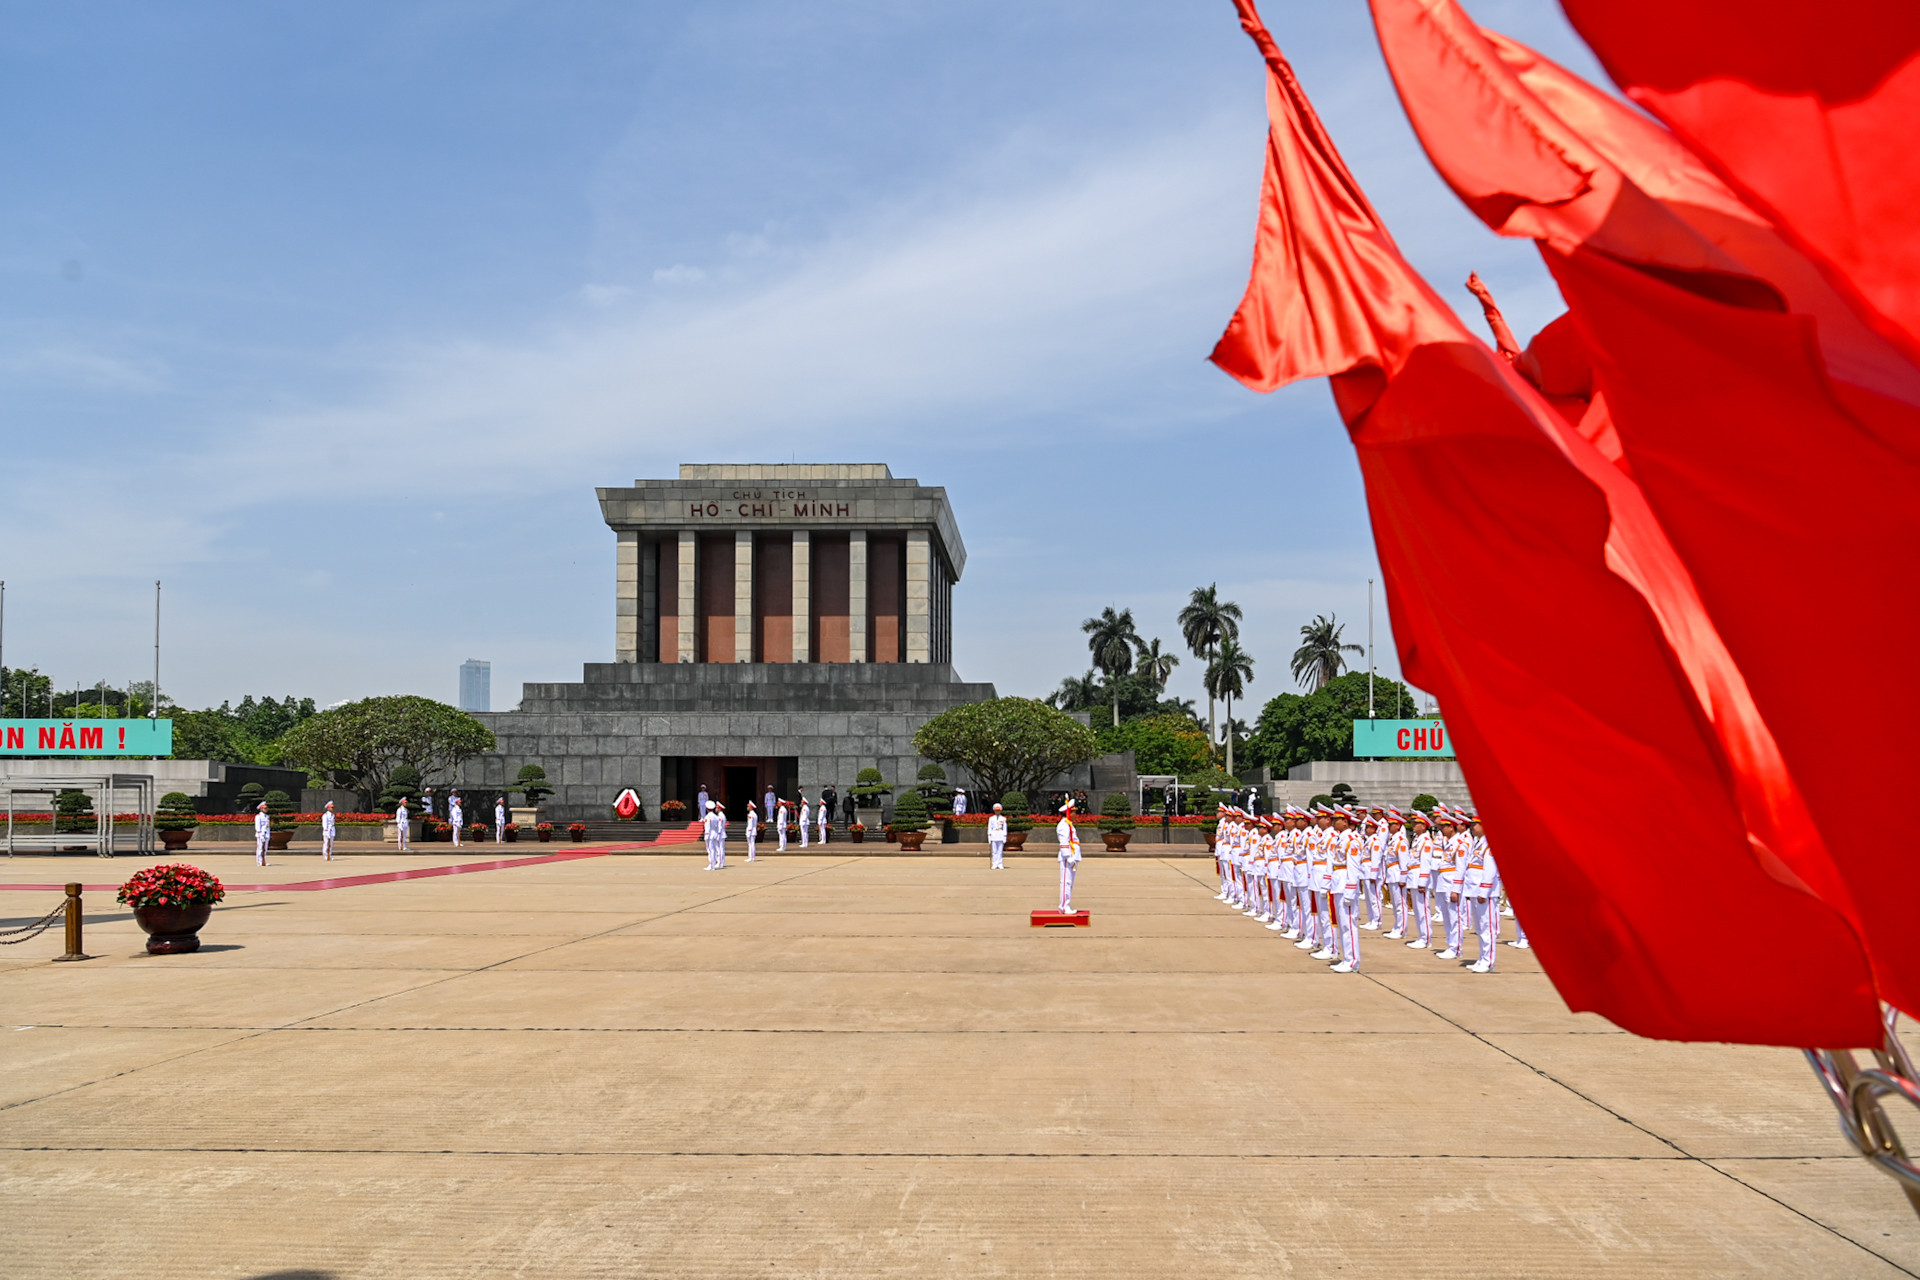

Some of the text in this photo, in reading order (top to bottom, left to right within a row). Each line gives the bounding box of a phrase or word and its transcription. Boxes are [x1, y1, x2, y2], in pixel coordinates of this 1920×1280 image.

[0, 722, 126, 750] N NĂM !
[1396, 720, 1444, 751] CHỦ
